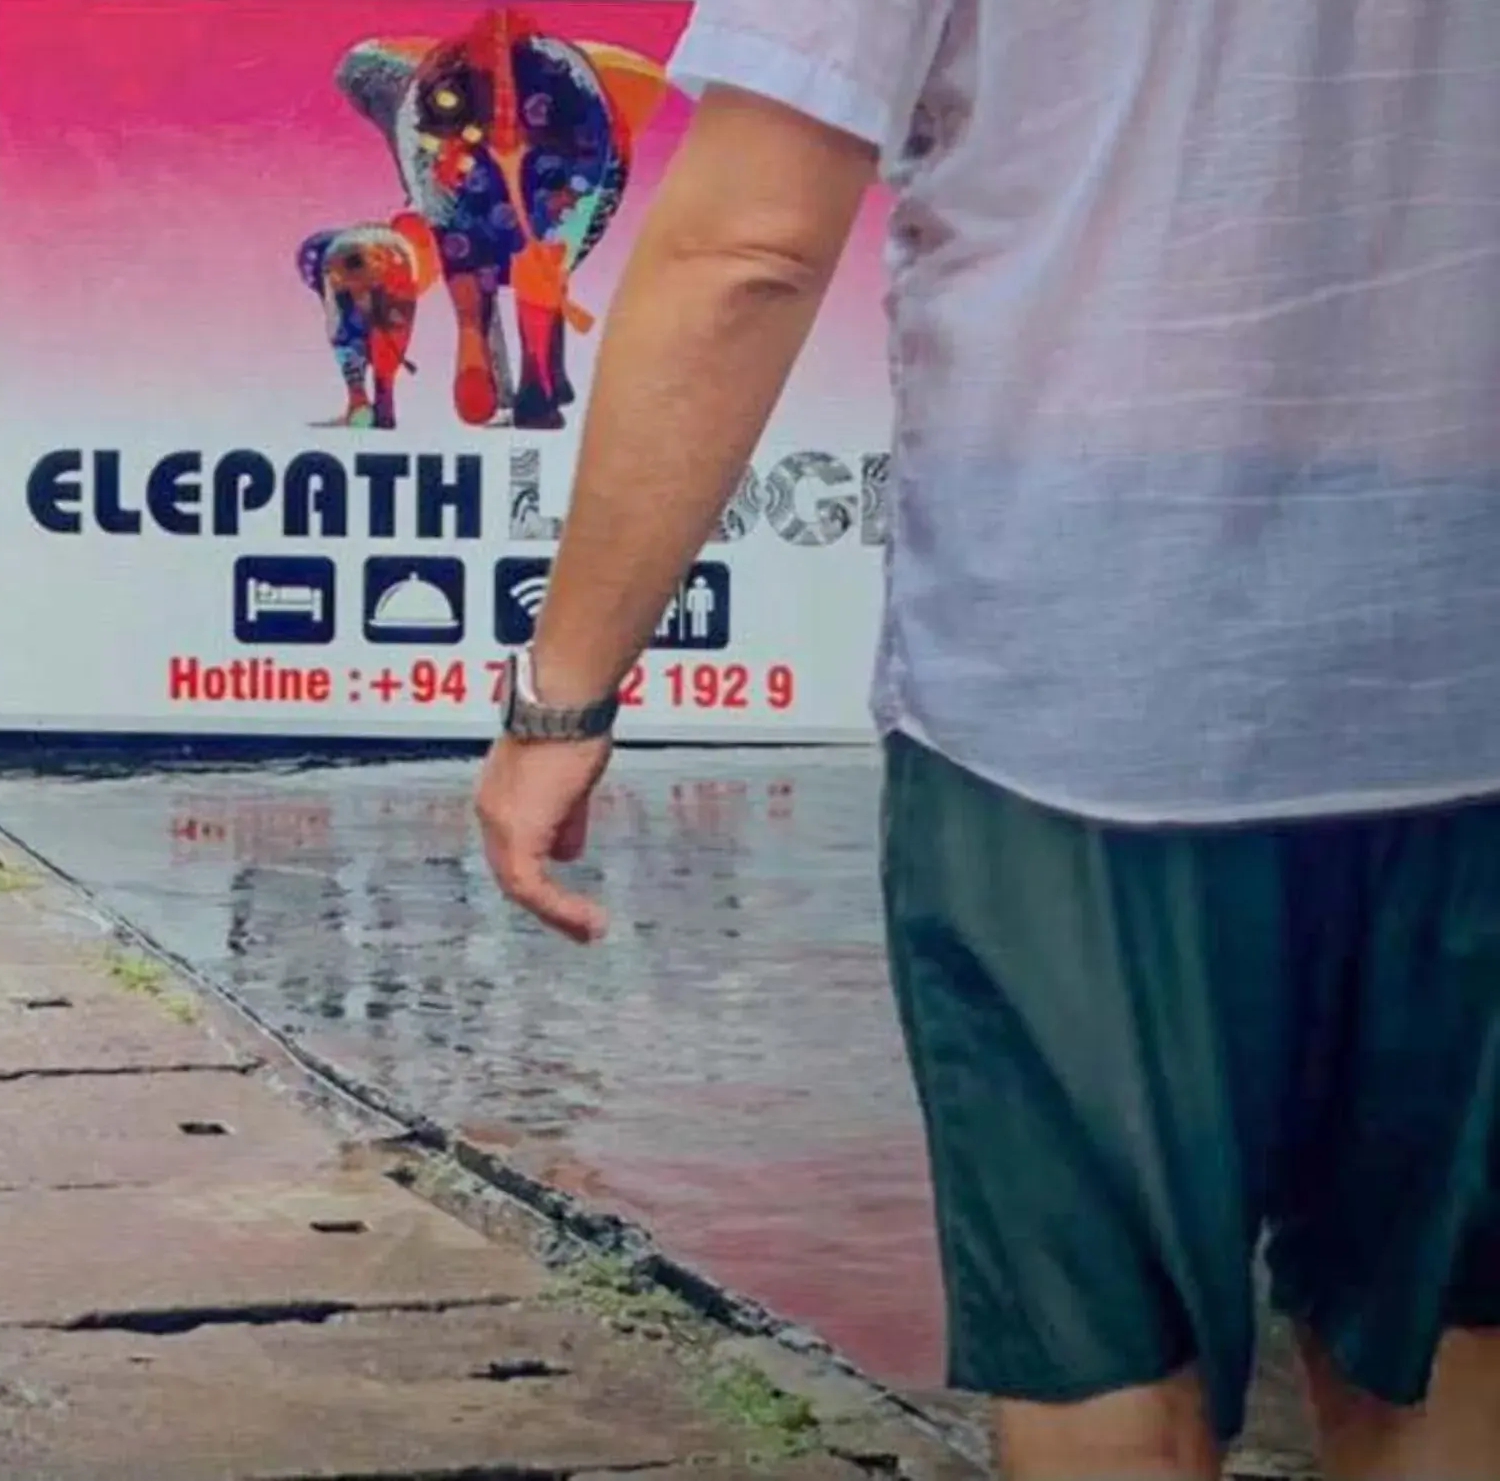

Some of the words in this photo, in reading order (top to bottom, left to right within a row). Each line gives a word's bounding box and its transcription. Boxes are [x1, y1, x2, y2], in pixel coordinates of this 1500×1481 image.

[26, 448, 482, 539] ELEPATH
[168, 656, 331, 702] Hotline
[663, 663, 749, 708] 192
[766, 664, 795, 709] 9
